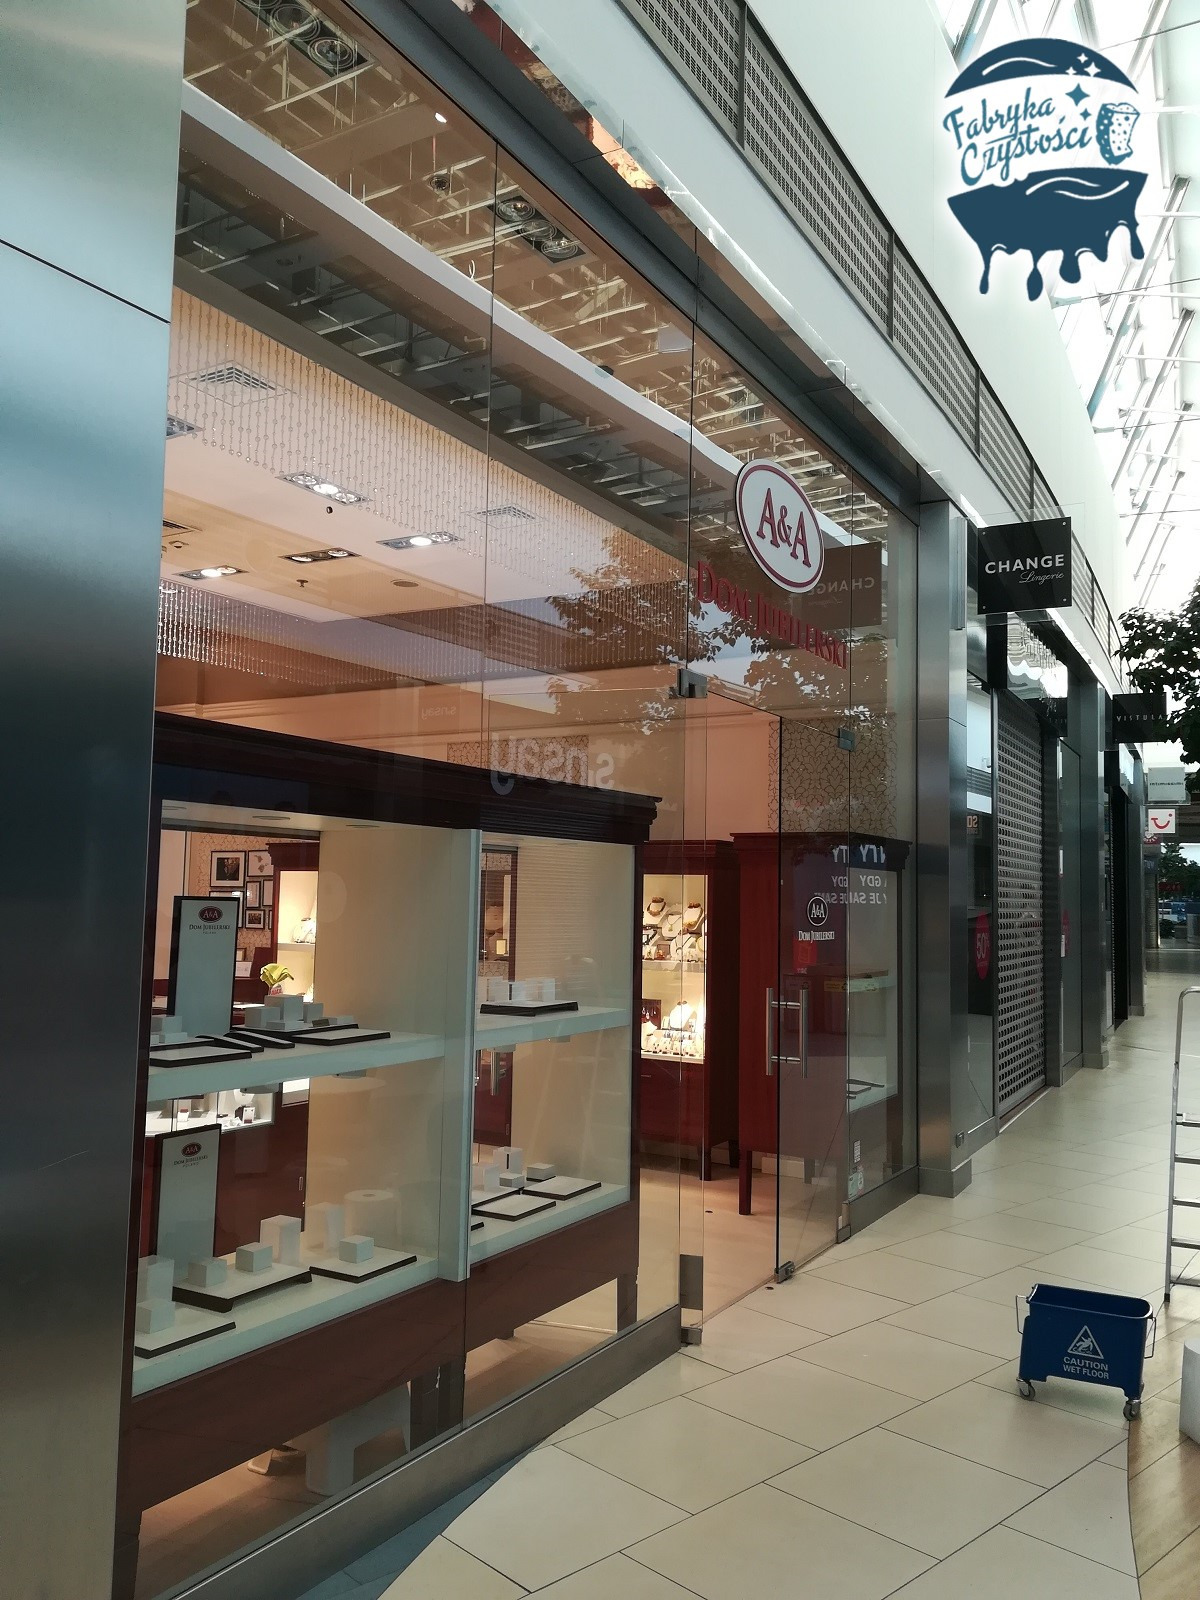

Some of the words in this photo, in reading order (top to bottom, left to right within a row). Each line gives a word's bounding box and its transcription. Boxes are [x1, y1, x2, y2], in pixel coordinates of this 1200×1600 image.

[756, 487, 812, 568] A&A
[984, 554, 1065, 574] CHANGE
[1019, 571, 1065, 585] Lingerie
[1116, 714, 1163, 723] VISTULA
[810, 902, 825, 918] A&A
[1063, 1356, 1109, 1371] CAUTION
[1063, 1364, 1081, 1374] WET
[1082, 1368, 1110, 1379] FLOOR
